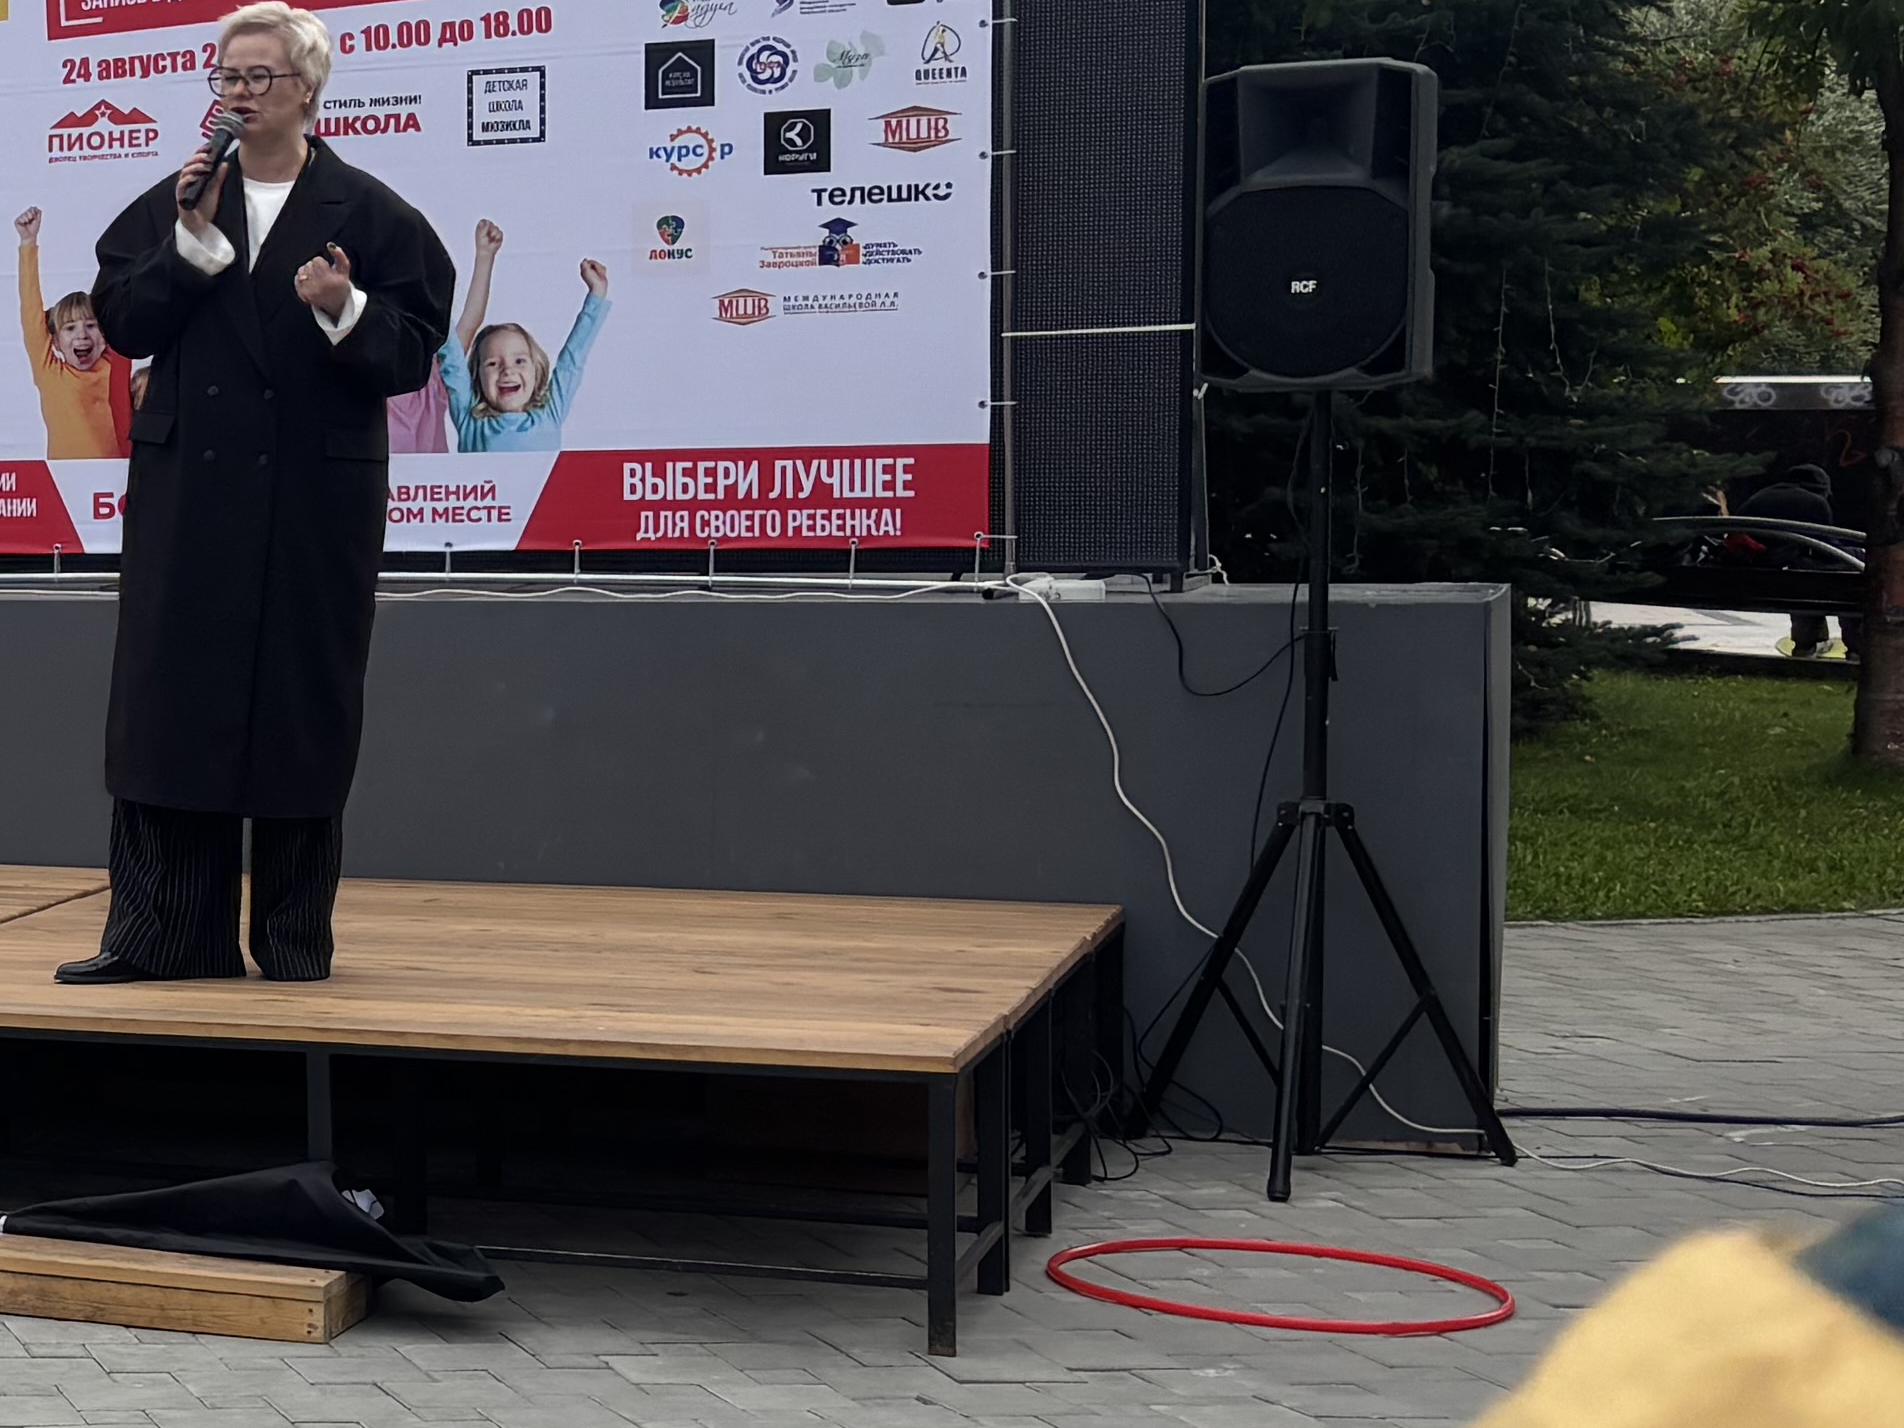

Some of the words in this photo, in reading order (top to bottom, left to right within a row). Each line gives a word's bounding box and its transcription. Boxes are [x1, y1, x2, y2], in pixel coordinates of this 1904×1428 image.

[360, 19, 431, 52] 10.00
[437, 19, 475, 48] до
[480, 6, 553, 40] 18.00
[62, 56, 92, 85] 24
[97, 48, 197, 82] августа
[484, 79, 528, 94] ДЕТСКАЯ
[488, 100, 523, 113] ШКОЛА
[314, 112, 422, 138] ШКОЛА
[482, 119, 531, 133] МЮЗИКЛА
[48, 128, 159, 153] ПИОНЕР
[1291, 280, 1317, 293] RCF
[623, 460, 759, 501] ВЫБЕРИ
[769, 457, 915, 500] ЛУЧШЕЕ
[387, 480, 496, 502] ВЛЕНИЙ
[388, 507, 424, 523] ОМ
[431, 505, 512, 524] МЕСТЕ
[636, 510, 690, 541] ДЛЯ
[695, 509, 781, 538] СВОЕГО
[787, 508, 902, 537] РЕБЕНКА!
